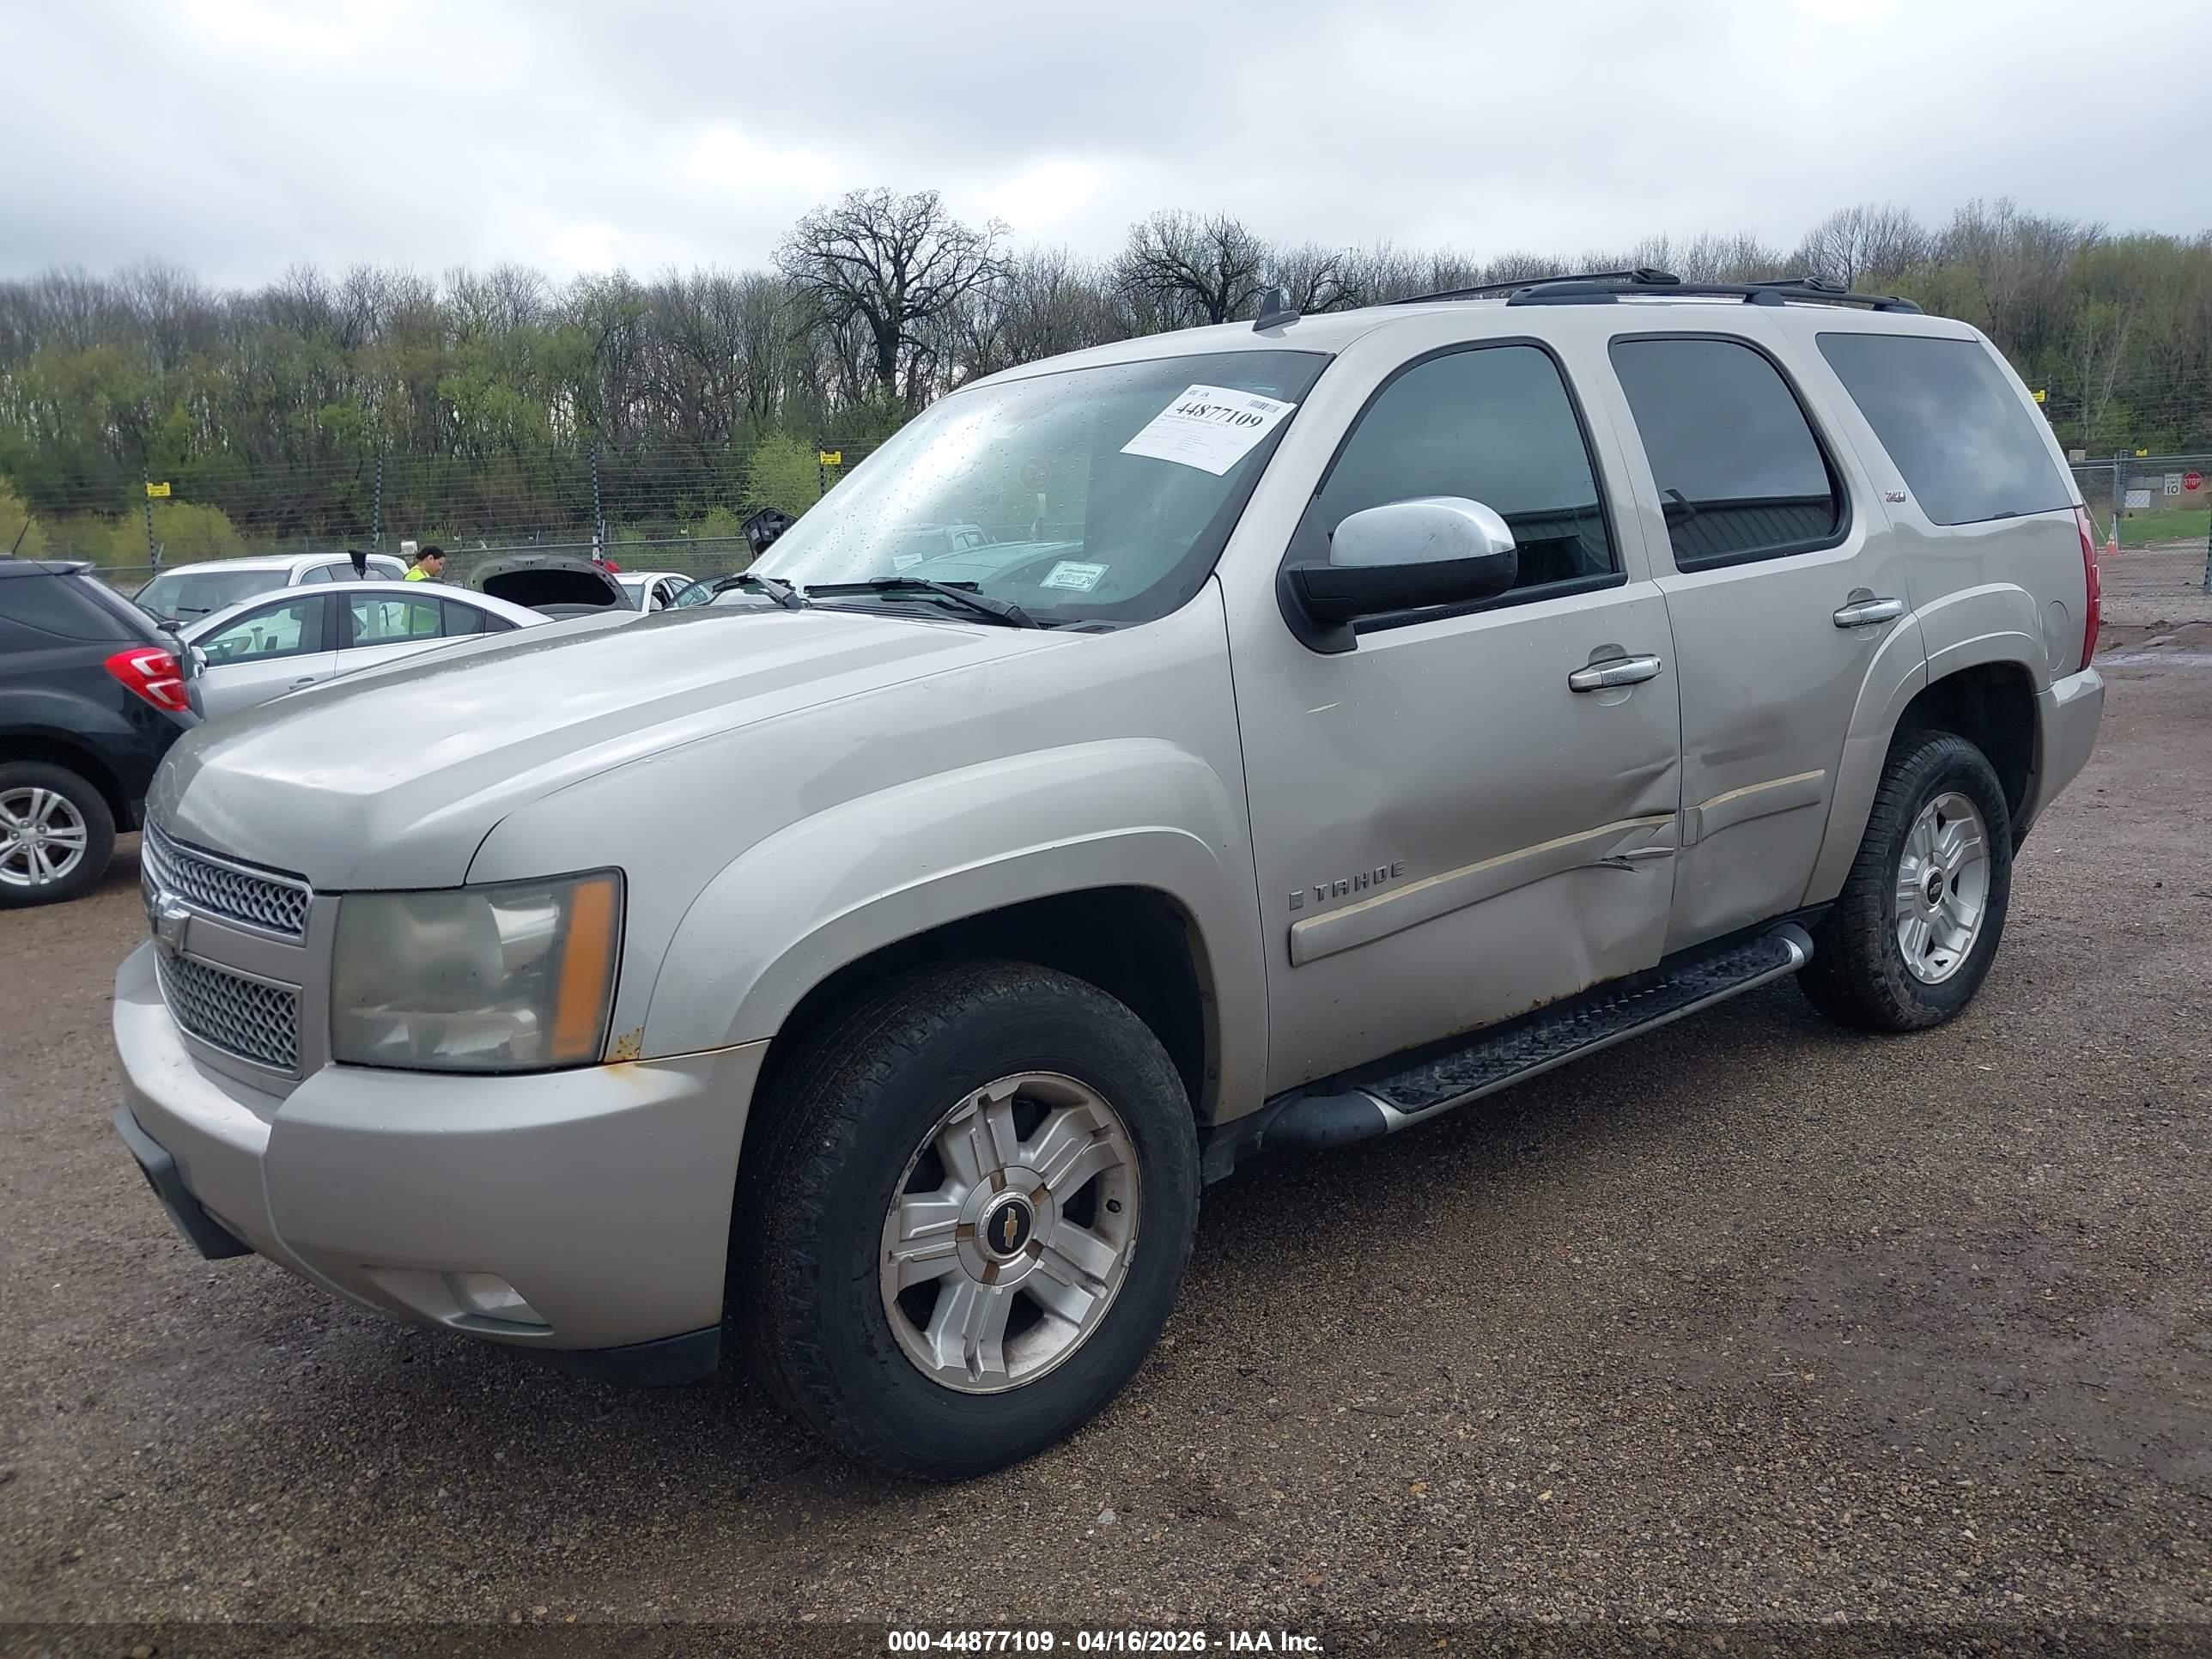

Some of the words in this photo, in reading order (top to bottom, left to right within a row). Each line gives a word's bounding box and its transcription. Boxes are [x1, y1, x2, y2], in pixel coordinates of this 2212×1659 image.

[1176, 402, 1263, 428] 44877109
[2166, 485, 2179, 494] 10
[1313, 859, 1406, 902] TAHOE
